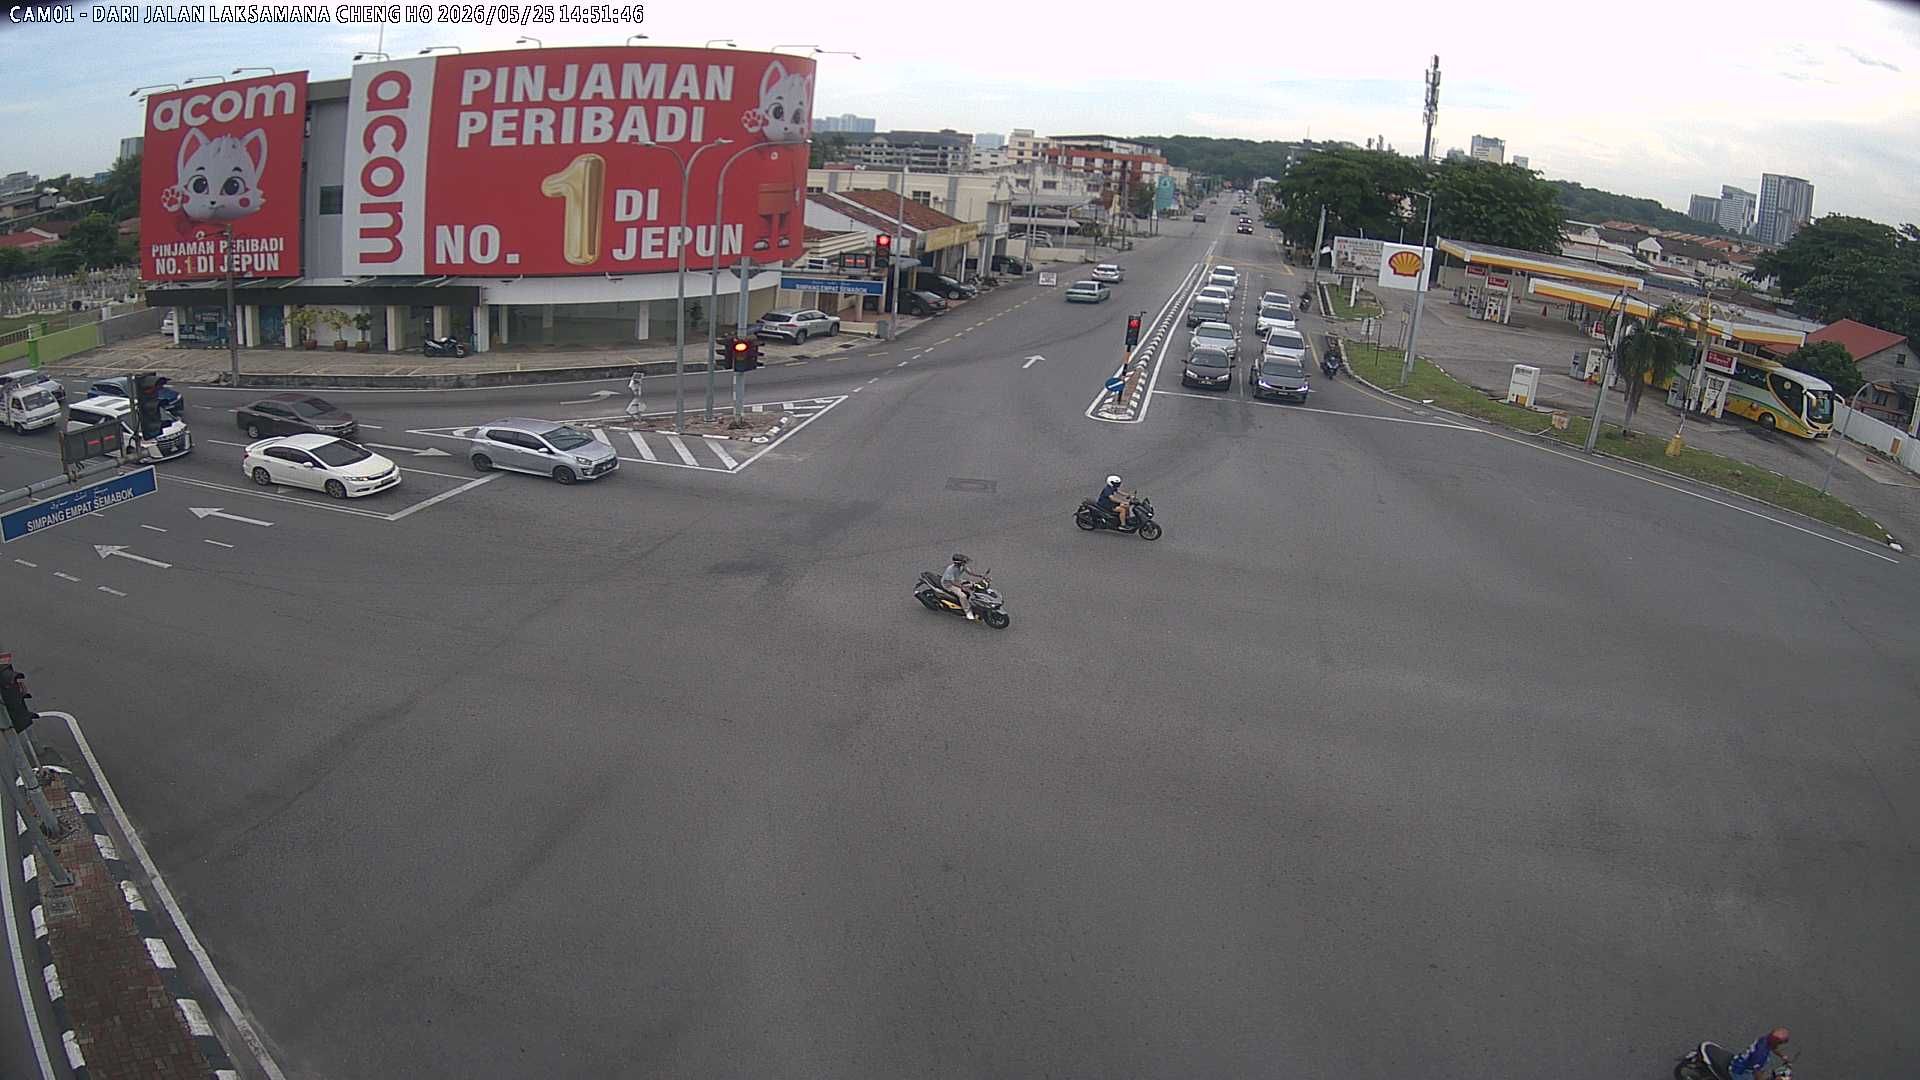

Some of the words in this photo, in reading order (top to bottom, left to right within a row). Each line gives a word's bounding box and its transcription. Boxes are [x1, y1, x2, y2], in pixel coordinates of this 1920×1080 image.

[461, 63, 735, 106] PINJAMAN
[153, 82, 296, 131] acom
[457, 105, 705, 148] PERIBADI
[359, 69, 413, 264] acom
[435, 224, 521, 265] NO.
[540, 152, 607, 265] 1
[615, 188, 660, 222] DI
[152, 240, 214, 257] PINJAMAN
[612, 223, 744, 261] JEPUN
[155, 257, 181, 275] NO.
[184, 255, 192, 273] 1
[197, 255, 214, 273] DI
[219, 253, 280, 273] JEPUN
[27, 510, 65, 532] SIMPANG
[66, 501, 92, 518] EMPAT
[94, 488, 134, 509] SEMABOK
